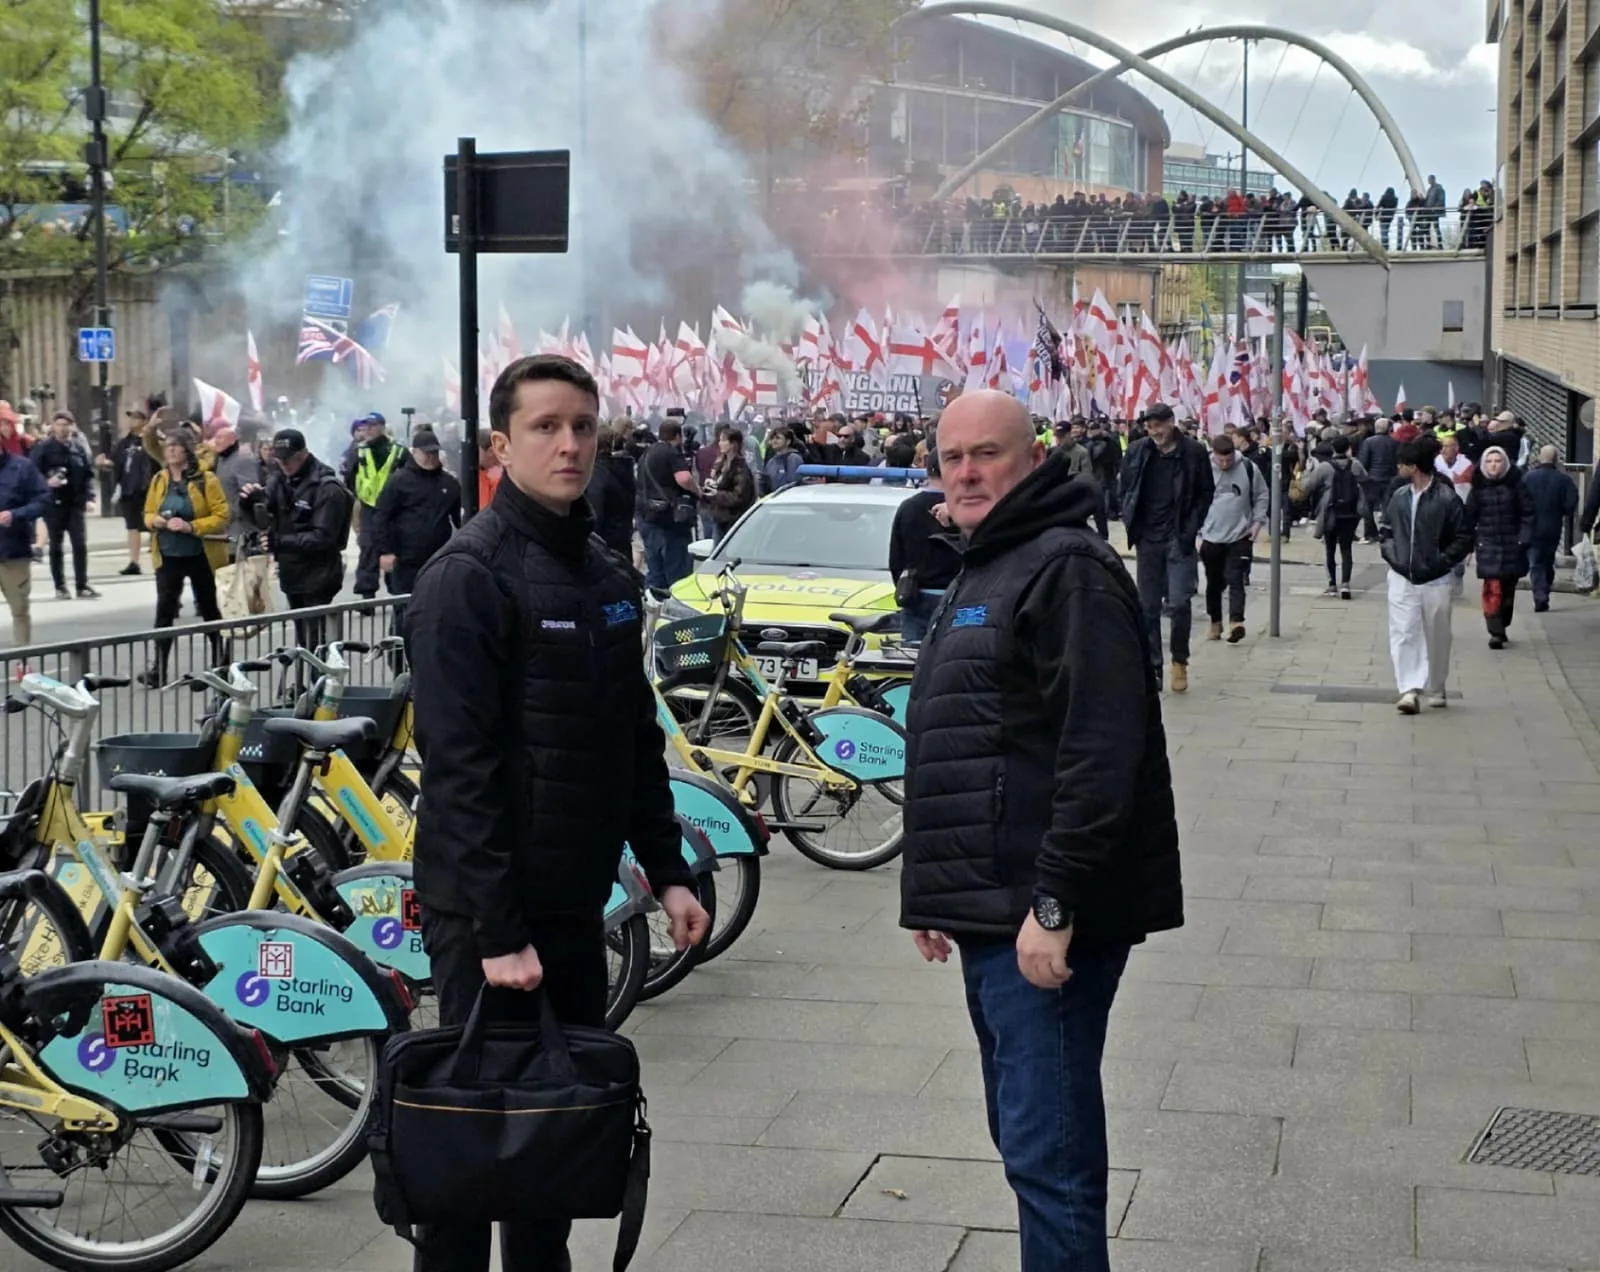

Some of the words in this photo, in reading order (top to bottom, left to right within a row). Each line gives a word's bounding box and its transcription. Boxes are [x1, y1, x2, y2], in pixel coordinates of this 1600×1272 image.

[844, 391, 923, 413] GEORGE
[745, 583, 851, 598] OLICE
[859, 753, 887, 766] Bank
[860, 741, 904, 760] Starling
[686, 814, 730, 833] arling
[277, 977, 353, 1003] Starling
[276, 994, 326, 1016] Bank
[123, 1058, 180, 1082] Bank
